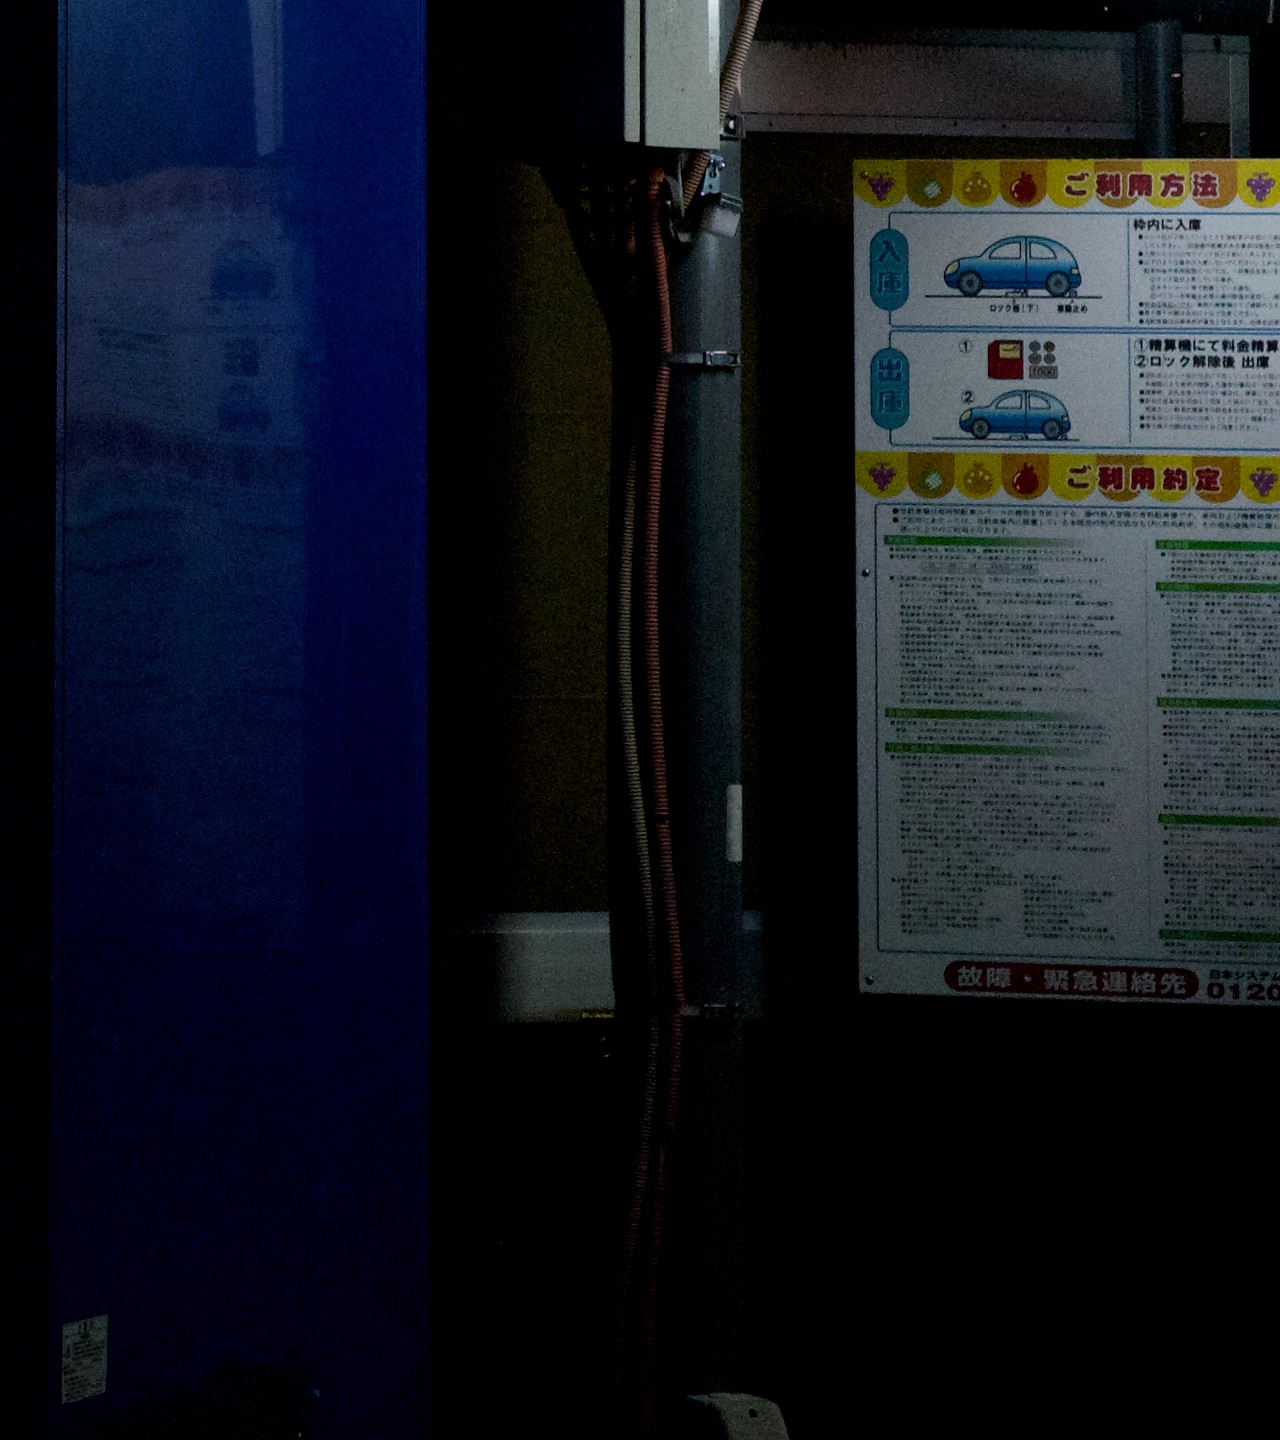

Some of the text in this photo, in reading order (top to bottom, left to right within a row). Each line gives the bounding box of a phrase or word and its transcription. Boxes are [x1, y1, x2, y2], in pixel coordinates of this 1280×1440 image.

[1065, 172, 1219, 199] ご利用方法
[1134, 218, 1202, 231] 枠内に入庫
[877, 239, 903, 295] 入庫
[877, 357, 903, 414] 出庫
[957, 964, 1188, 997] 故障・緊急連絡先
